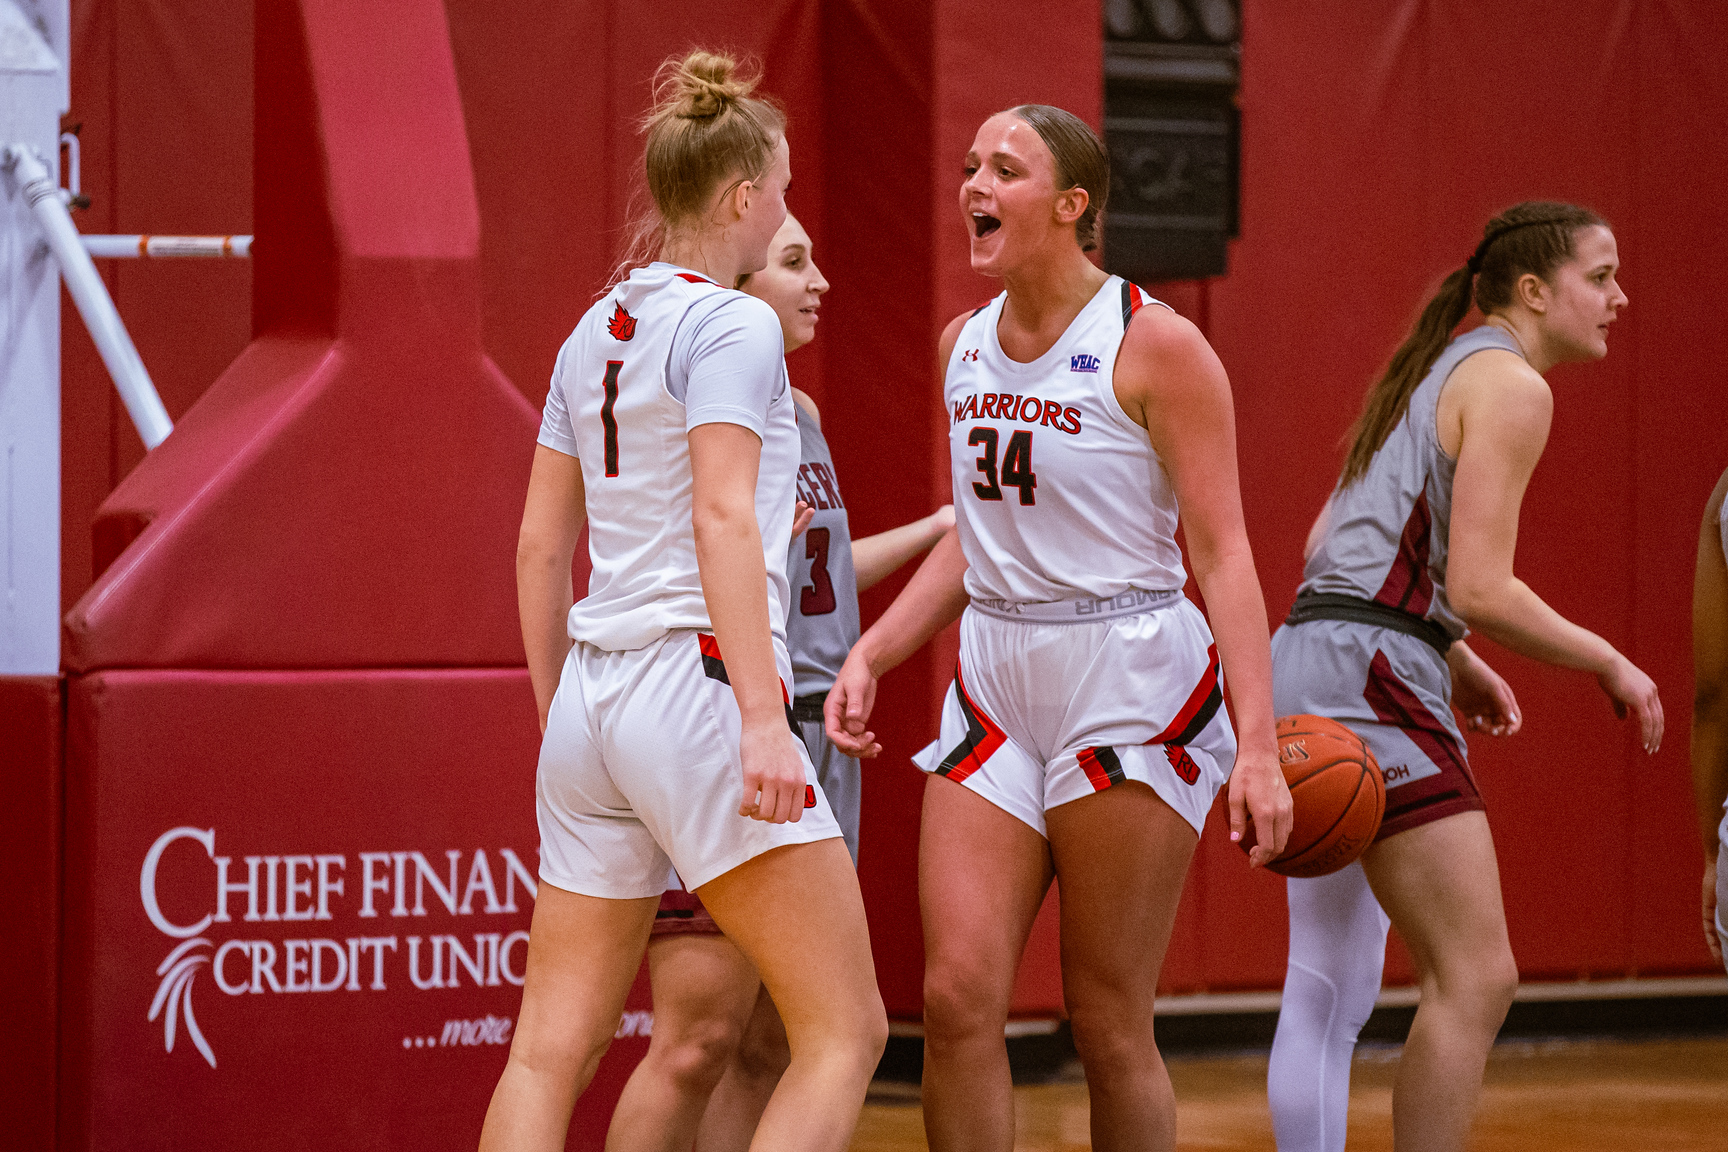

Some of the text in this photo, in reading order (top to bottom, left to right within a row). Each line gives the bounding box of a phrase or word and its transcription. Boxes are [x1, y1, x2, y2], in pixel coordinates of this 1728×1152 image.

[1071, 354, 1101, 370] WHAC
[601, 360, 624, 478] 1
[953, 393, 1082, 435] WARRIORS
[967, 426, 1038, 507] 34
[800, 527, 837, 616] 3
[140, 826, 539, 938] CHIEF FINAN
[212, 930, 530, 996] CREDIT UNIO
